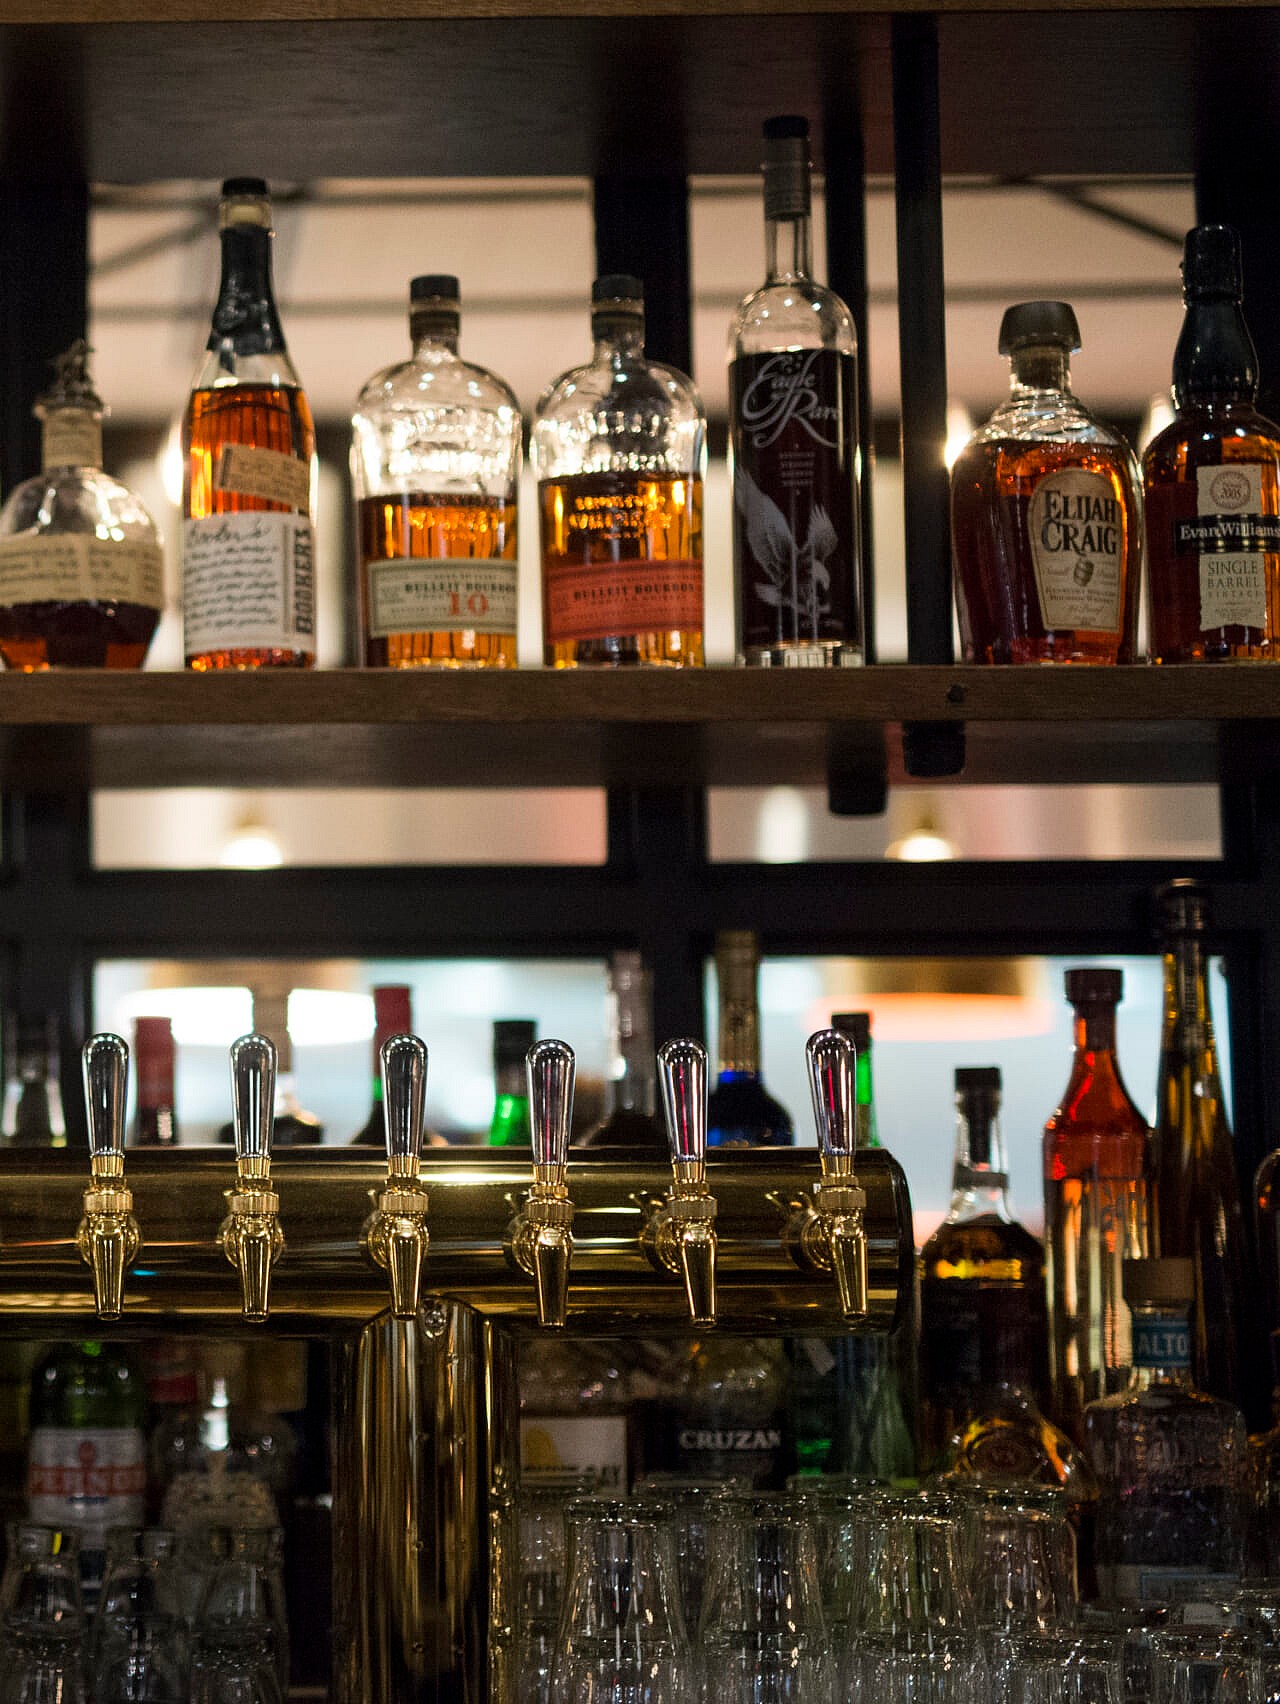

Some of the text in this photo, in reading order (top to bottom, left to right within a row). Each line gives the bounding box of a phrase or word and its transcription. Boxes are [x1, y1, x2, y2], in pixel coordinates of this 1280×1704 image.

[1045, 490, 1116, 524] ELIJAH
[1041, 519, 1117, 556] CRAIG
[1179, 523, 1220, 541] Evan
[1208, 560, 1259, 576] SINGLE
[1208, 577, 1259, 588] BARREL
[448, 592, 490, 616] 10
[678, 1428, 782, 1451] CRUZAN
